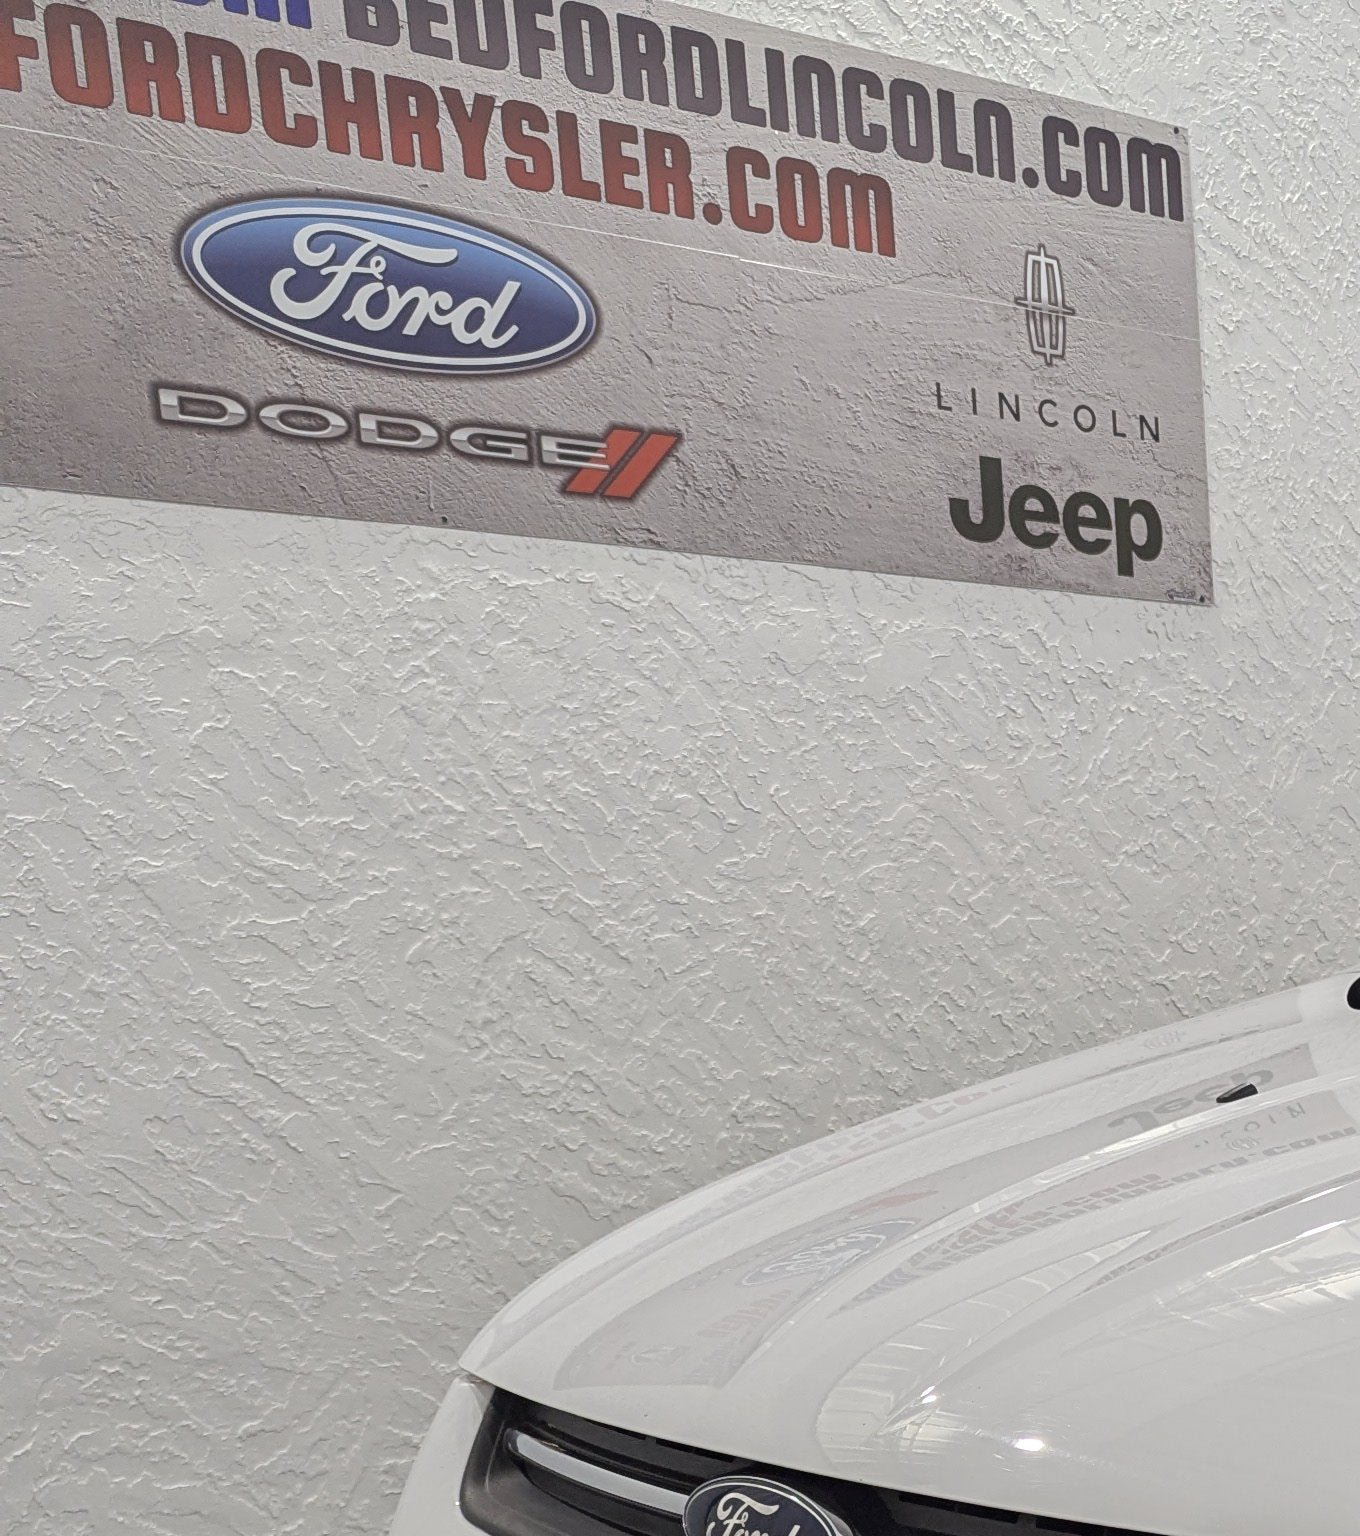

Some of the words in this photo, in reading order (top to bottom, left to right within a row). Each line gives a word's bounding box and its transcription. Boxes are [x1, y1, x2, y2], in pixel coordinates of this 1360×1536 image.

[270, 222, 520, 349] Ford
[157, 388, 610, 471] DODGE
[935, 381, 1161, 443] LINCOLN
[948, 455, 1163, 577] Jeep
